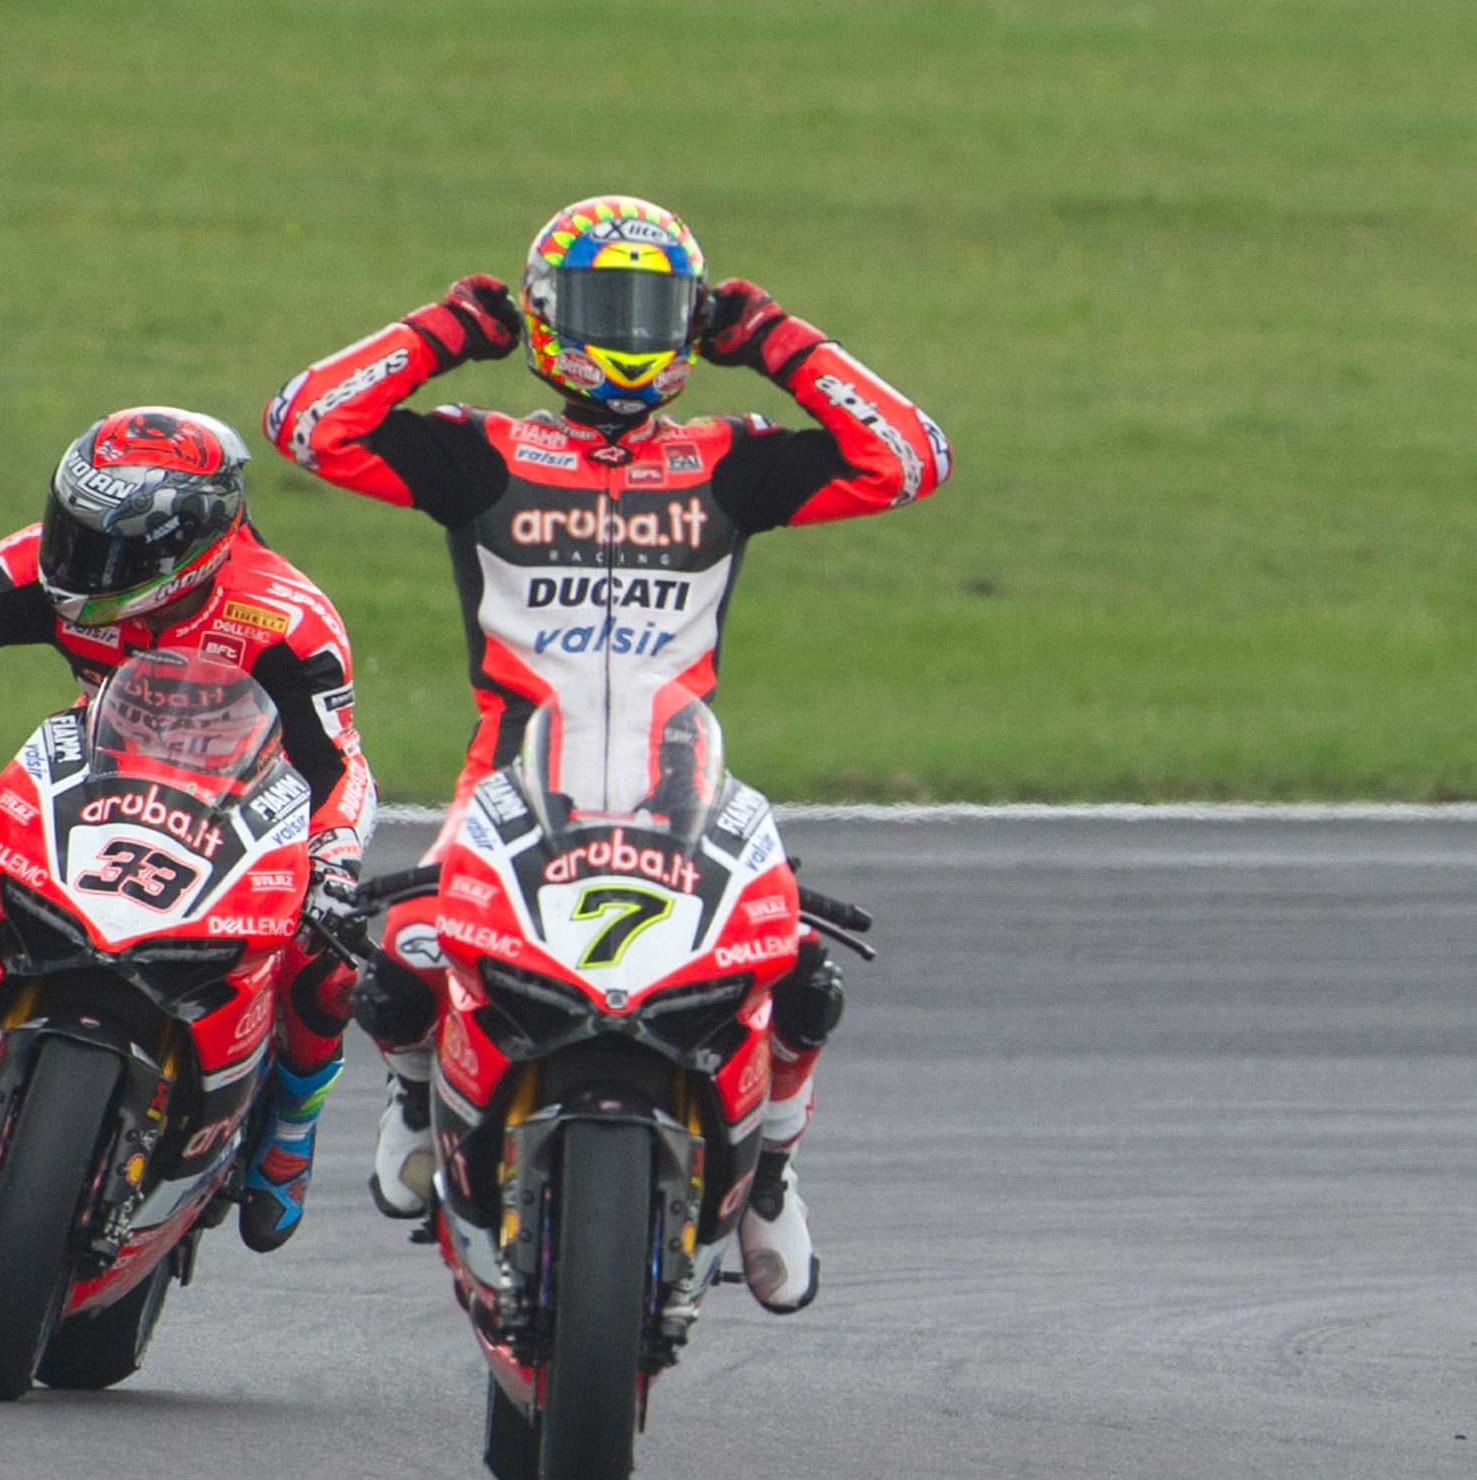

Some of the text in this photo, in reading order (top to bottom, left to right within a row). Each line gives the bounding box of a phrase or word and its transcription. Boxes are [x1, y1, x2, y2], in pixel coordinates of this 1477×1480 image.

[65, 449, 138, 502] NOLAN
[516, 448, 575, 468] valsir
[509, 492, 709, 550] aruba.it
[549, 550, 671, 566] RACING
[526, 576, 691, 612] DUCATI
[533, 616, 676, 657] valsir
[23, 742, 43, 782] valsir
[50, 714, 83, 764] FIAMM
[80, 783, 225, 859] aruba.it
[249, 773, 308, 823] FIAMM
[272, 814, 308, 847] valsir
[73, 836, 212, 915] 33
[543, 827, 702, 895] aruba.it
[571, 884, 675, 970] 7
[714, 934, 800, 968] DELLEM
